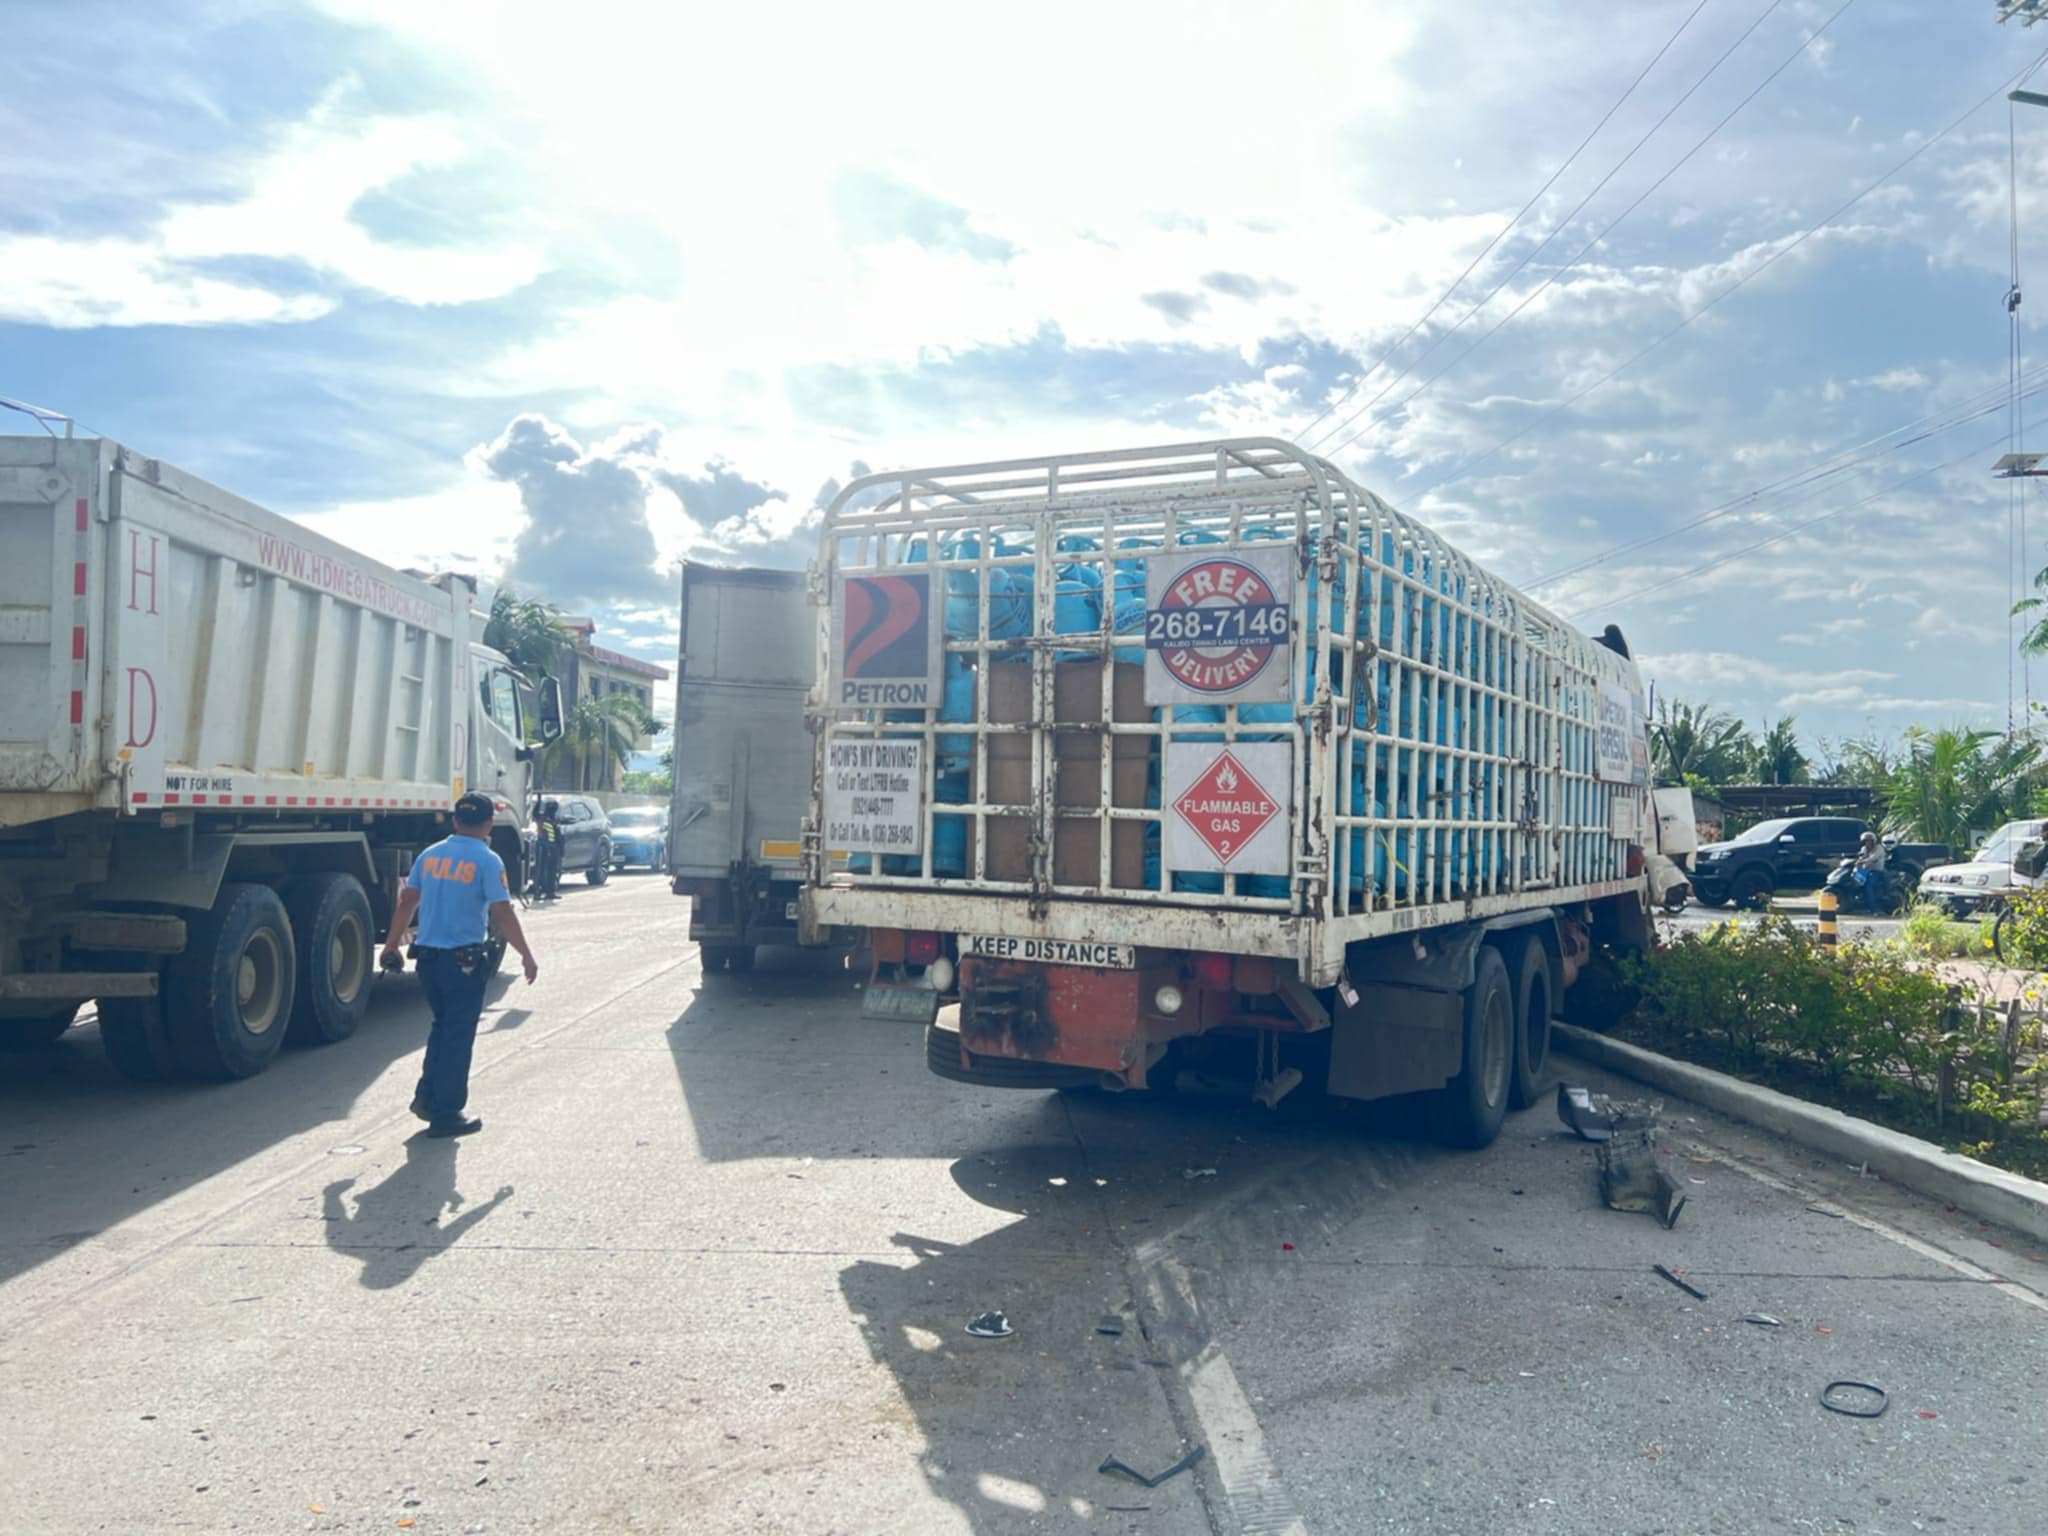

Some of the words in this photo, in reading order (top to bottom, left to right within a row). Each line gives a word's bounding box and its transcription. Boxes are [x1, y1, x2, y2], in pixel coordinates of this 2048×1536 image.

[1175, 567, 1259, 606] FREE
[1149, 607, 1287, 639] 268-7146
[1170, 648, 1259, 684] DELIVERY
[842, 681, 927, 704] PETRON
[830, 744, 858, 767] HOW'S
[860, 745, 873, 768] MY
[876, 746, 917, 769] DRIVING?
[166, 777, 187, 790] NOT
[190, 778, 209, 791] FOR
[211, 779, 233, 792] HIRE
[1183, 800, 1269, 815] FLAMMABLE
[1211, 819, 1241, 832] GAS
[1221, 840, 1231, 854] 2
[422, 856, 477, 883] PULIS
[972, 936, 1018, 956] KEEP
[1025, 940, 1119, 965] DISTANCE
